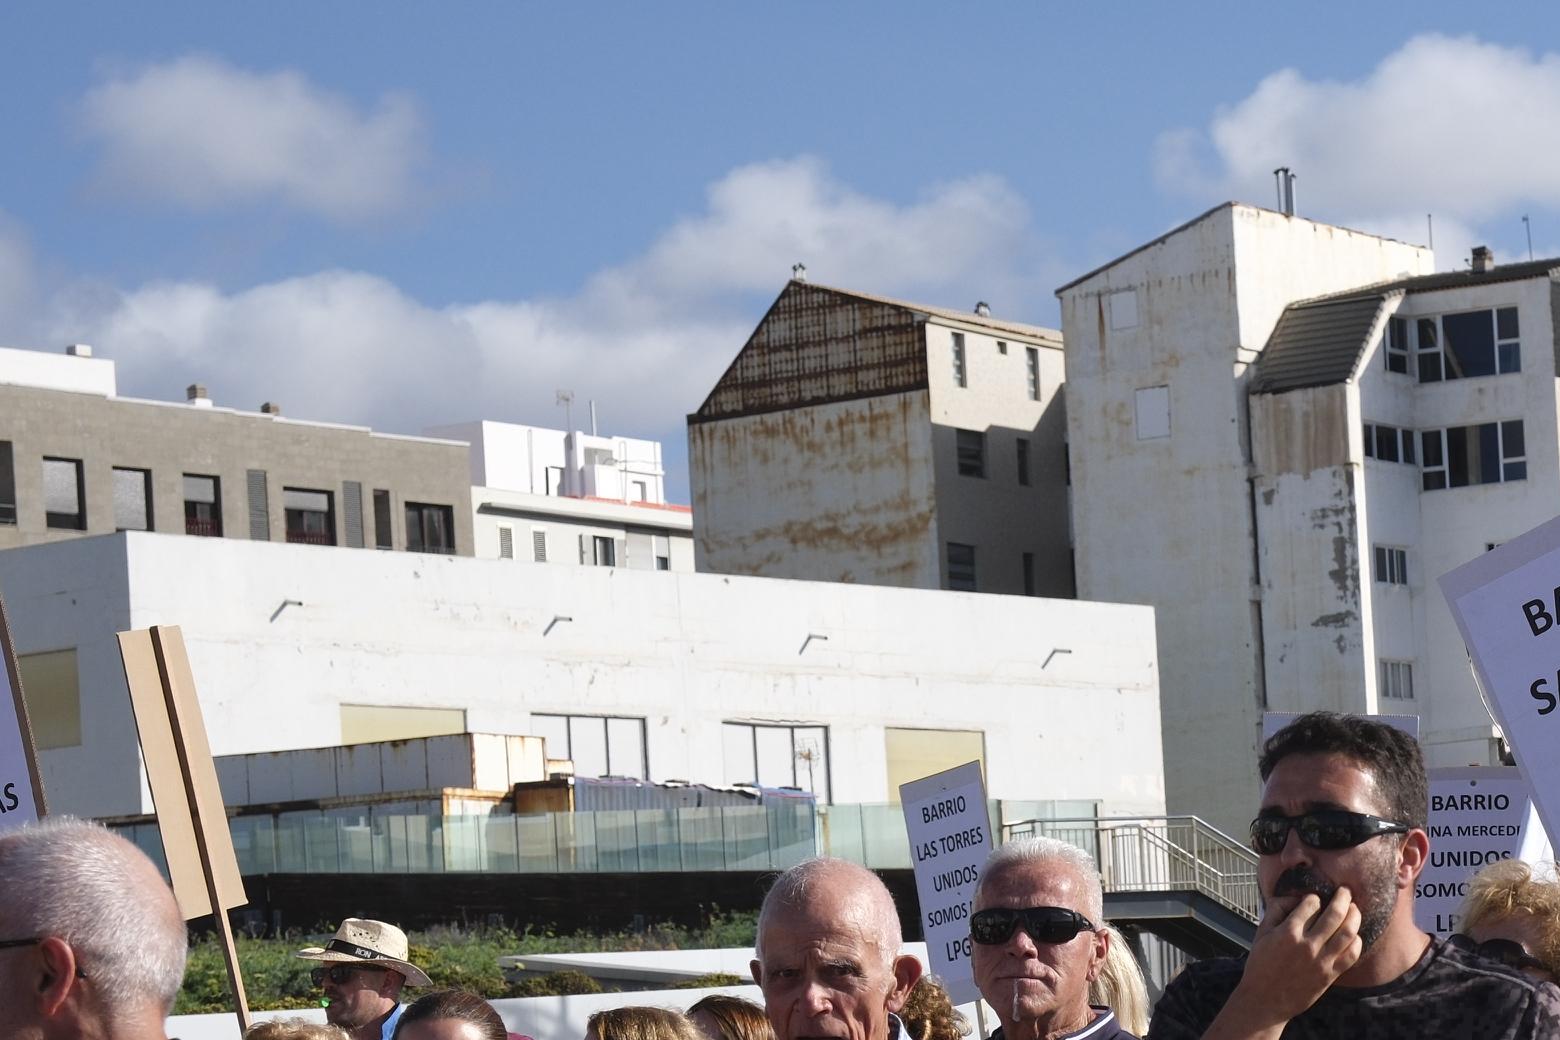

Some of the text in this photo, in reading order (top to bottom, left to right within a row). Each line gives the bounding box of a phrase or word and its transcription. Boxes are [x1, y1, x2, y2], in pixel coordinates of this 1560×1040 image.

[921, 795, 966, 823] BARRIO
[1431, 794, 1510, 811] BARRIO
[1427, 825, 1521, 837] INA MERCED
[917, 826, 983, 861] LAS TORRES
[1431, 850, 1511, 868] UNIDOS
[933, 864, 978, 892] UNIDOS
[928, 904, 968, 928] SOMOS
[946, 937, 971, 961] LPG
